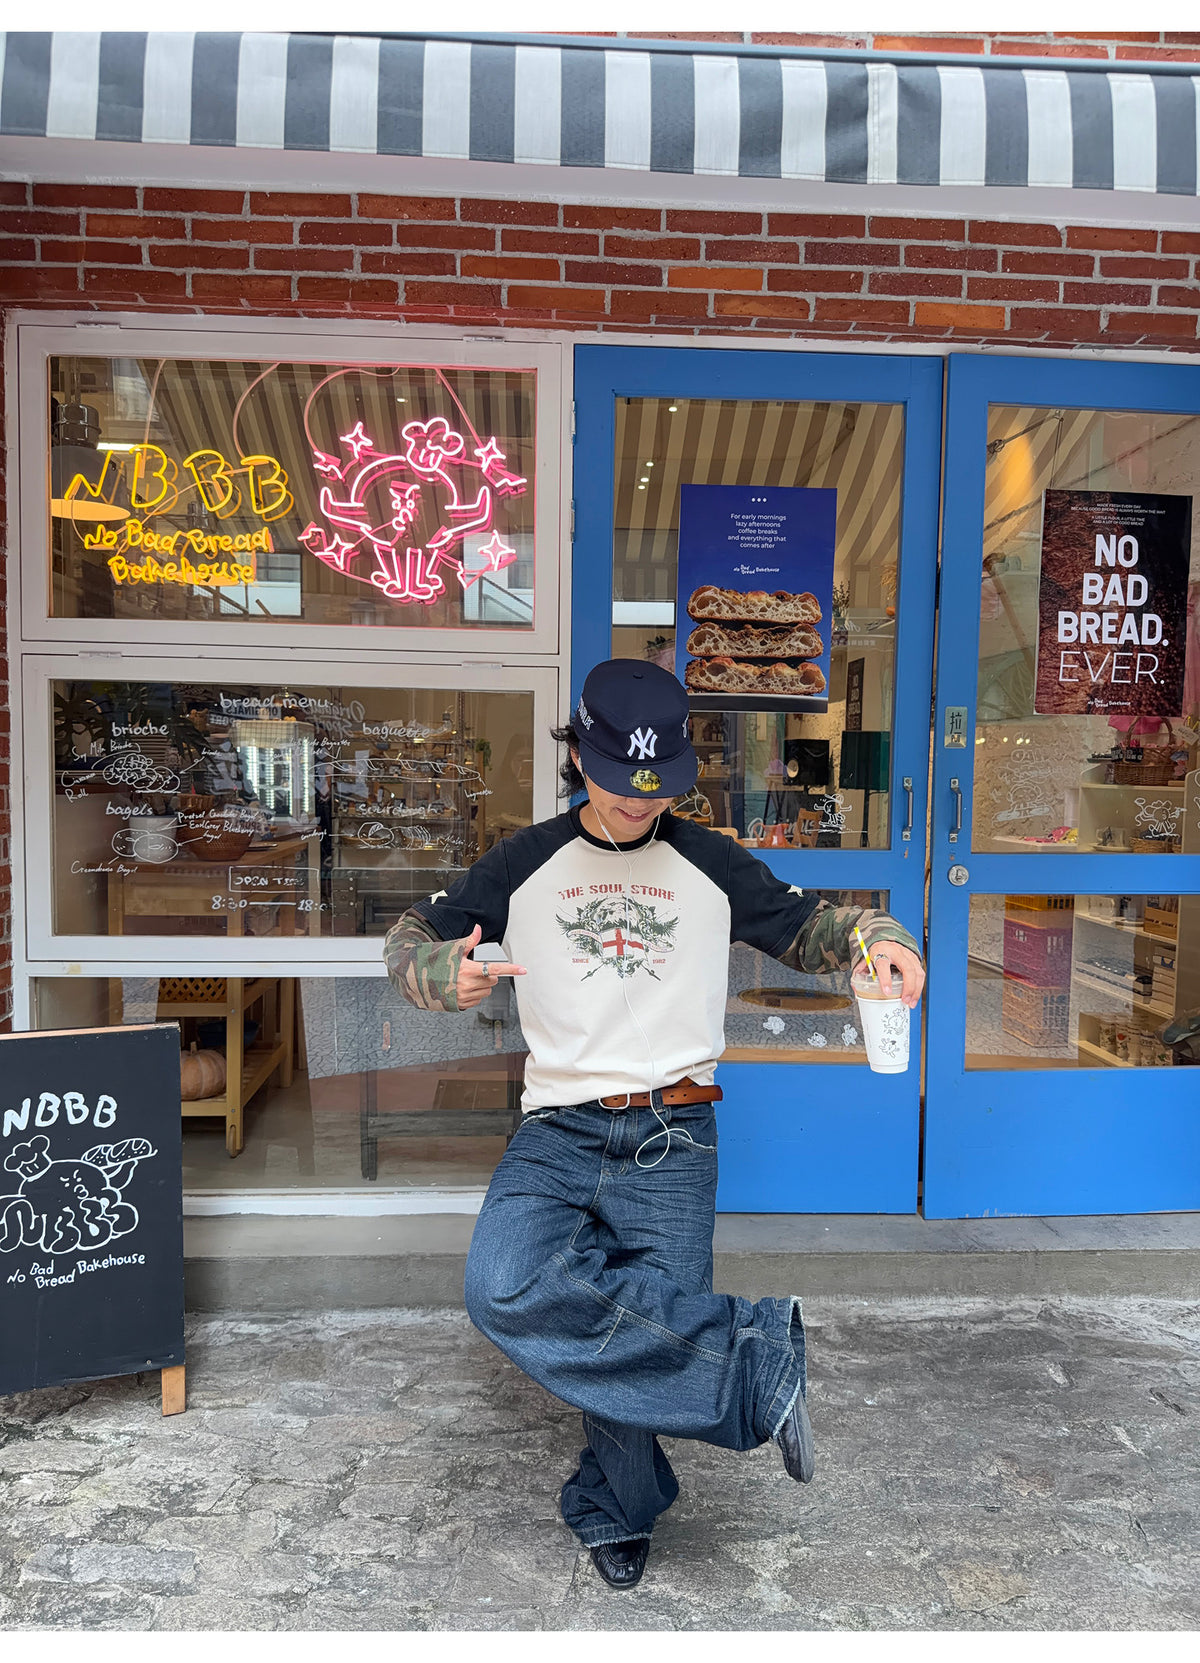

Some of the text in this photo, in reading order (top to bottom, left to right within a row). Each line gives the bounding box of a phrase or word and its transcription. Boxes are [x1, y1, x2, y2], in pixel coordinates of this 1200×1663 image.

[65, 444, 288, 516] NBBB
[757, 514, 787, 522] mornings
[84, 518, 270, 555] No Bad Bread
[740, 535, 773, 543] everything
[1094, 533, 1139, 568] NO
[107, 555, 256, 584] Bakehouse
[1082, 572, 1149, 607] BAD
[1057, 610, 1169, 647] BREAD.
[1058, 650, 1165, 685] EVER.
[219, 692, 275, 708] bread
[111, 722, 170, 737] brioche
[362, 723, 432, 740] baguette
[950, 712, 962, 735] 拉
[627, 726, 658, 760] NY
[105, 802, 153, 820] bagels
[297, 898, 336, 913] 18:0
[558, 883, 675, 902] THE SOUL STORE
[2, 1091, 118, 1137] NBBB
[6, 1252, 146, 1289] No Bad Bread Bakehouse
